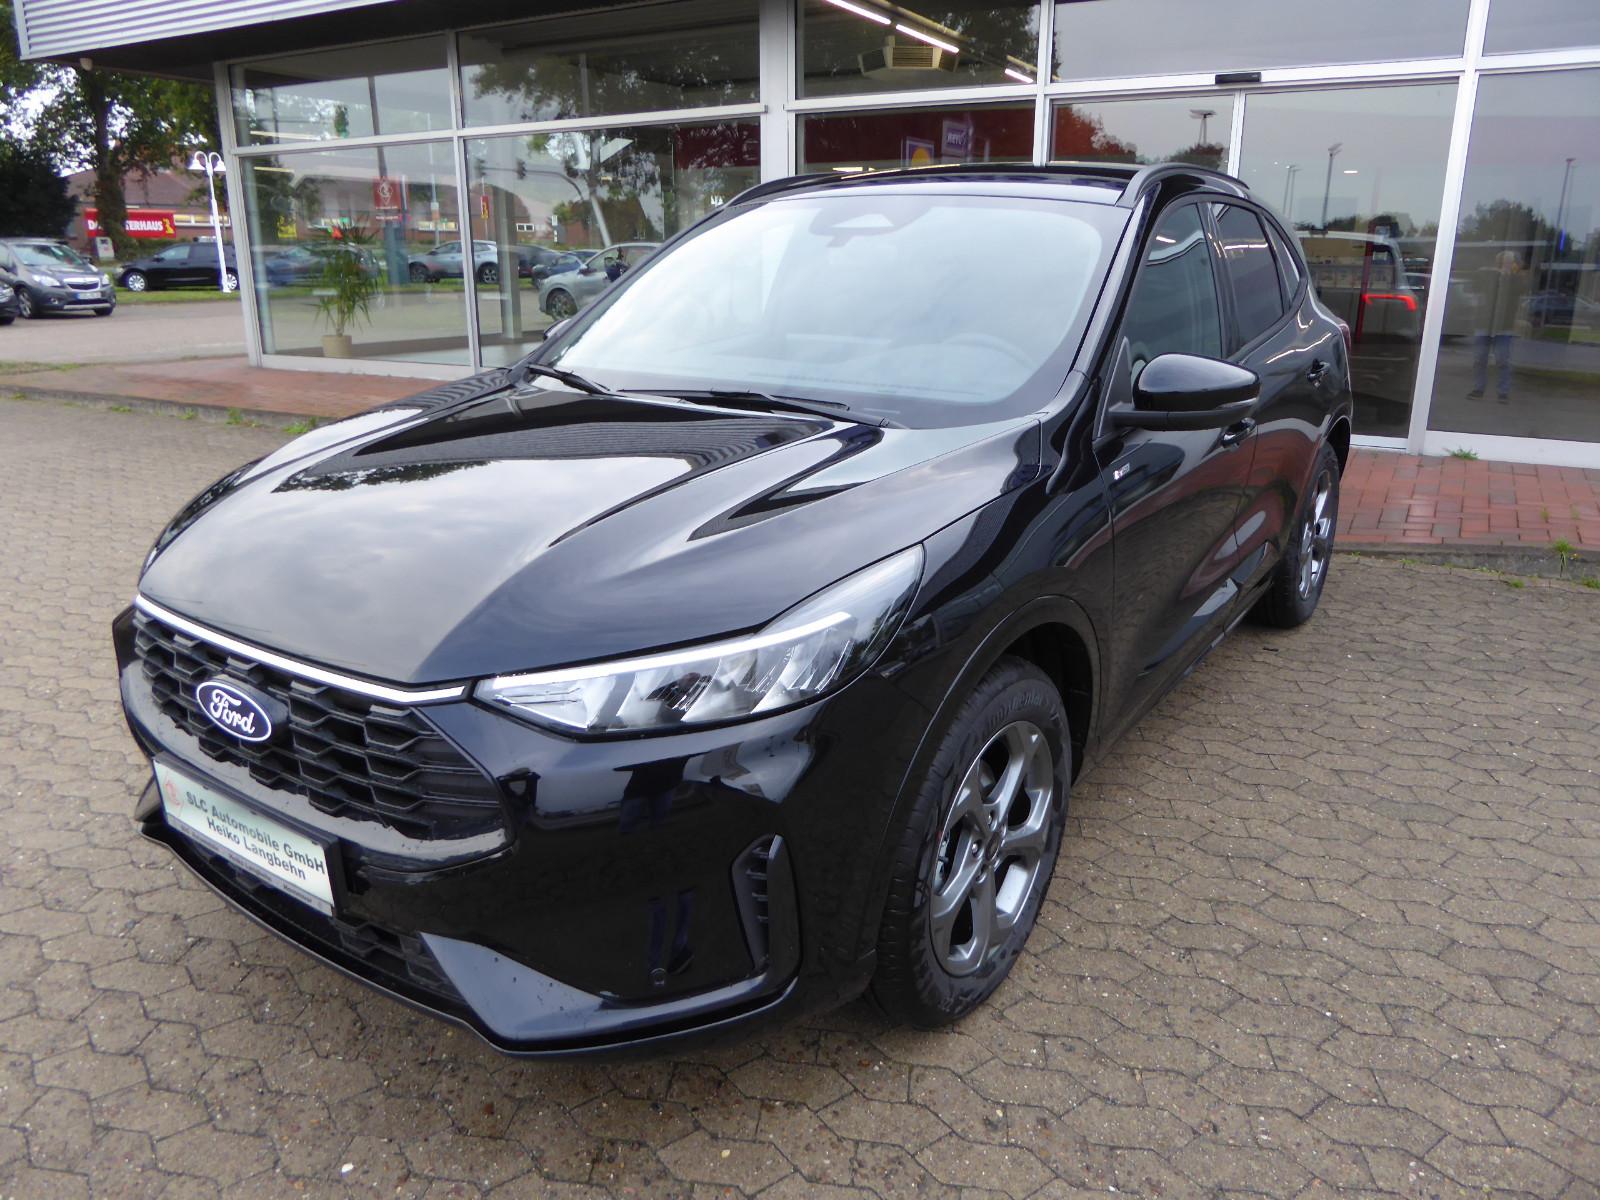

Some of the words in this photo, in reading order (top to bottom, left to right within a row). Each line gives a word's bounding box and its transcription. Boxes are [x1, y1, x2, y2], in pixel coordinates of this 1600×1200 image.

[125, 219, 163, 231] TERHAUS
[210, 689, 256, 734] Ford
[186, 791, 208, 813] SLC
[211, 805, 280, 851] Automobile
[283, 843, 326, 875] GmbH
[207, 817, 240, 846] Heiko
[243, 837, 306, 880] Langbehn
